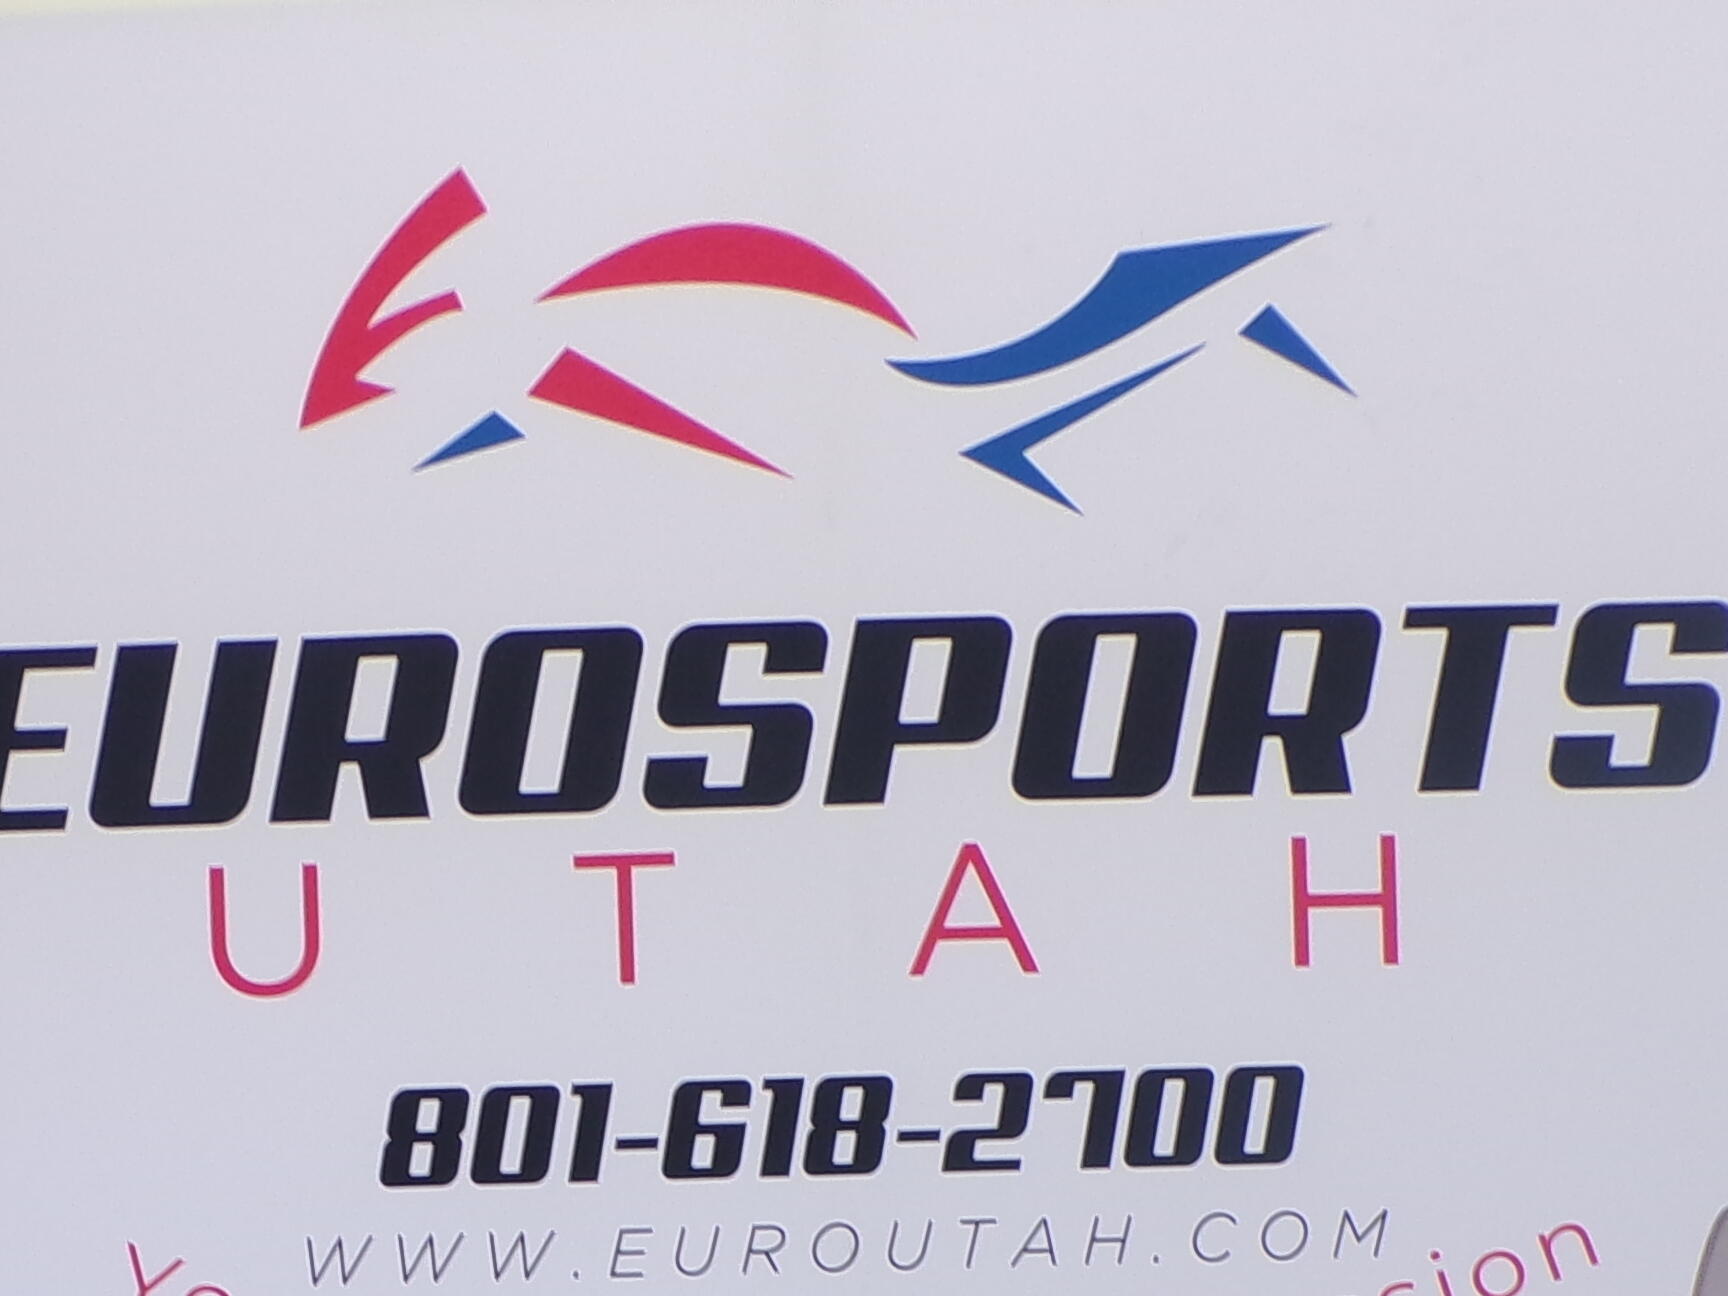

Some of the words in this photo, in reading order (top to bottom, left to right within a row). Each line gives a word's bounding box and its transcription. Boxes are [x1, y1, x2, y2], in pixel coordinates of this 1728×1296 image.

[207, 834, 1402, 999] UTAH
[378, 1064, 1305, 1188] 801-618-2700
[305, 1207, 1390, 1289] WWW.EUROUTAH.COM
